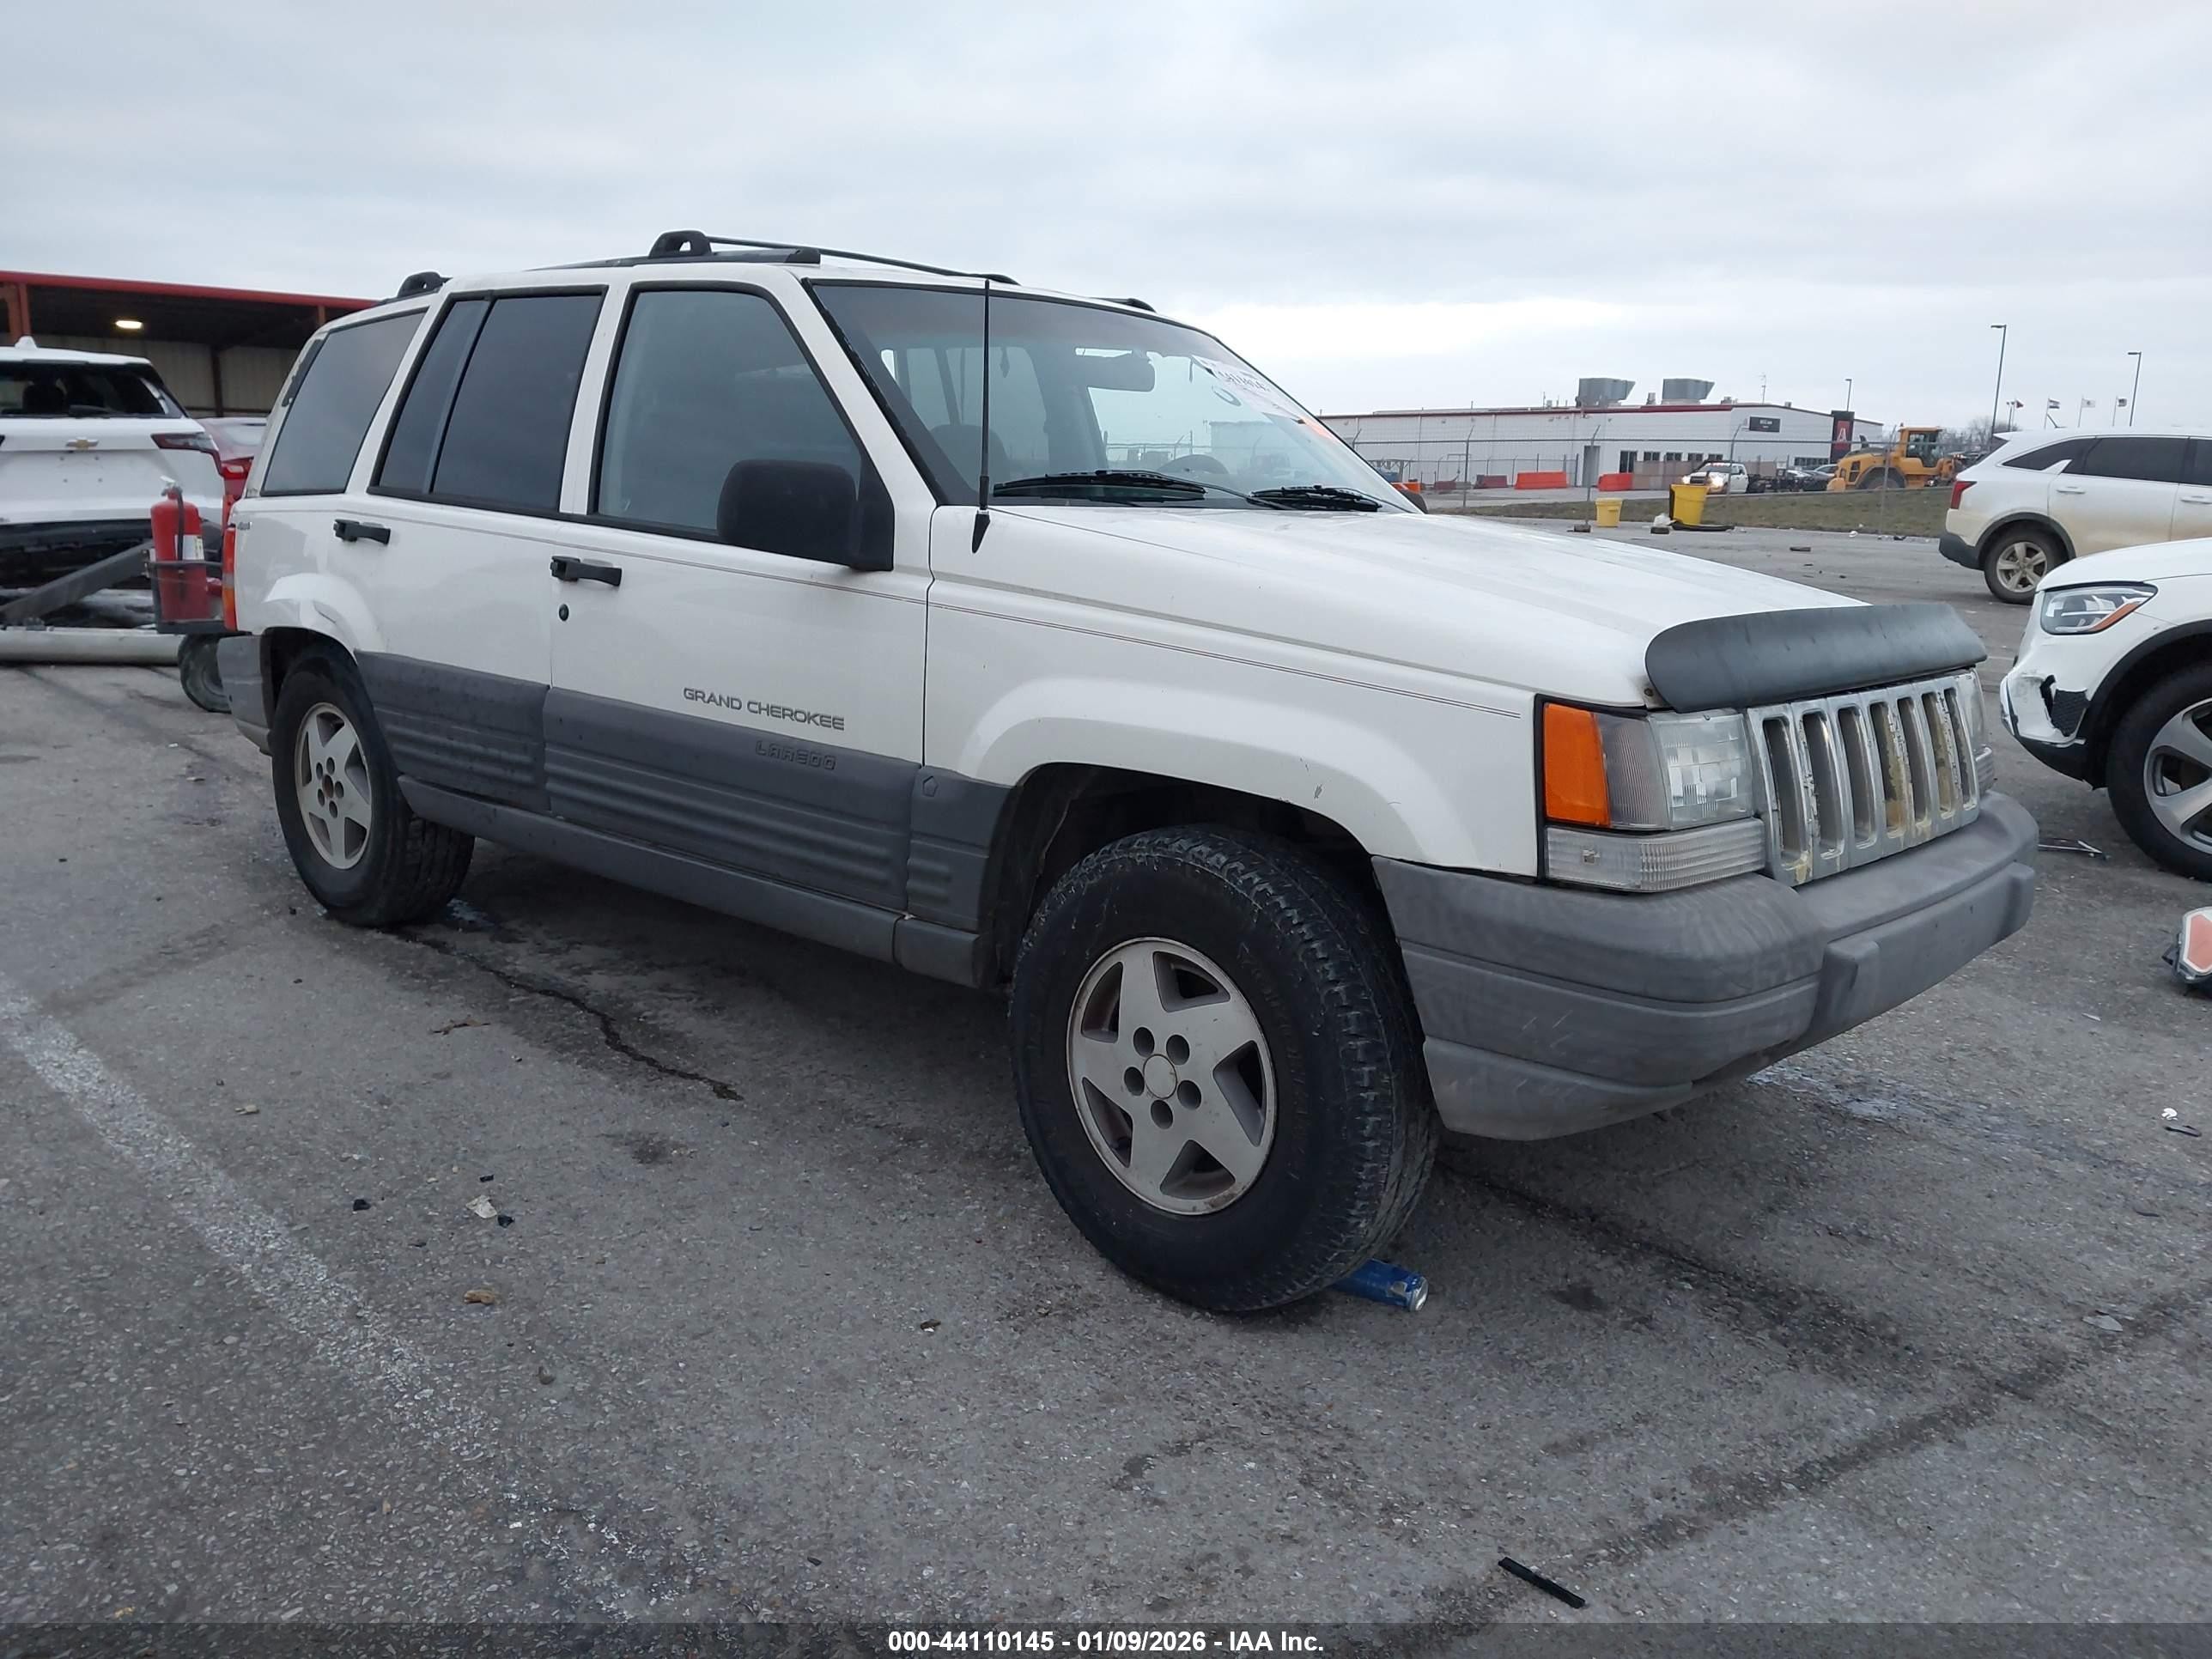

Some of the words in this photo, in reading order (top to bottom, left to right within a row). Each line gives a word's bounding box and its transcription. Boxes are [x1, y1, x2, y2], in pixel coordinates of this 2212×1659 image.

[684, 688, 743, 710] GRAND
[747, 700, 845, 731] CHEROKEE
[756, 740, 836, 770] LAREDO
